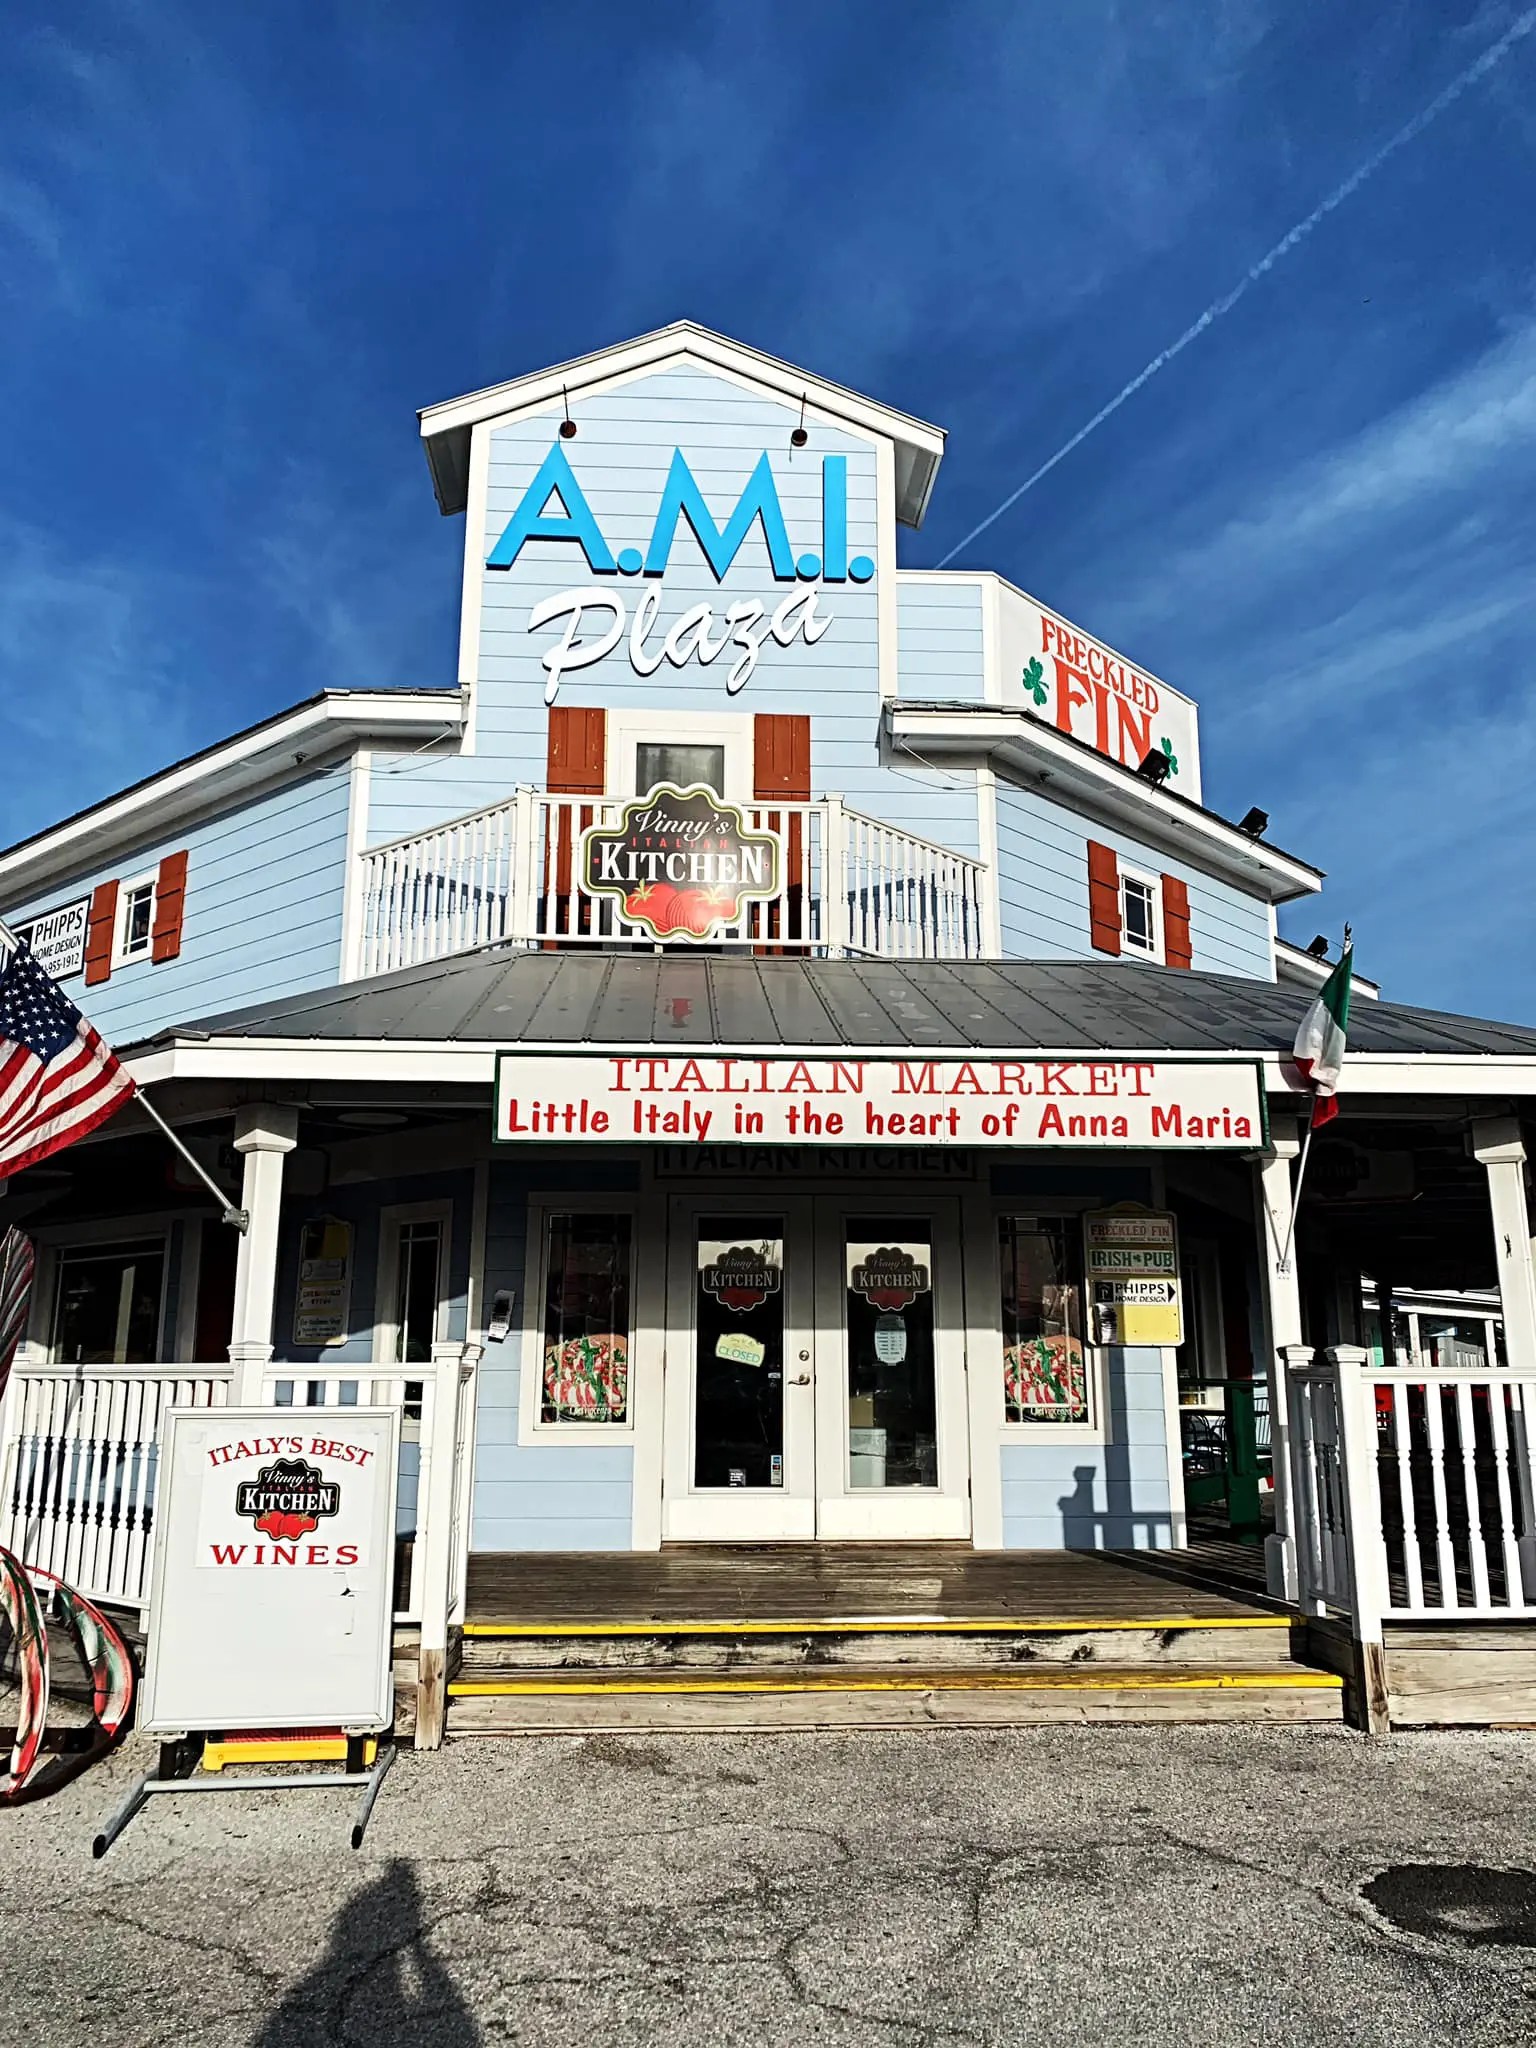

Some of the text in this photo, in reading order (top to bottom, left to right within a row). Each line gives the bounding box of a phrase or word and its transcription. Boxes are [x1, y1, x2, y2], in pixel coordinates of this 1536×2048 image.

[486, 442, 876, 583] A.M.I.
[527, 580, 836, 705] Plaza
[1040, 615, 1159, 714] FRECKLED
[1051, 655, 1152, 766] FIN
[635, 810, 733, 842] Vinny's
[631, 837, 729, 849] ITALIAN
[598, 842, 765, 884] KITCHEN
[34, 907, 84, 945] PHIPPS
[32, 934, 82, 961] HOME DESIGN
[608, 1058, 1155, 1097] ITALIAN MARKET
[508, 1098, 1252, 1142] Little Italy in the heart of Anna Maria
[661, 1146, 968, 1173] ITALIAN KITCHEN
[1090, 1224, 1170, 1237] FRECKLED FIN
[1091, 1250, 1174, 1267] IRISH PUB
[710, 1270, 773, 1288] KITCHEN
[859, 1270, 922, 1288] KITCHEN
[1114, 1283, 1165, 1295] PHIPPS
[1115, 1295, 1138, 1303] HOME
[718, 1345, 761, 1363] CLOSED
[208, 1436, 374, 1468] ITALY'S BEST
[264, 1470, 316, 1487] Vinny's
[243, 1487, 333, 1511] KITCHEN
[209, 1544, 360, 1565] WINES
